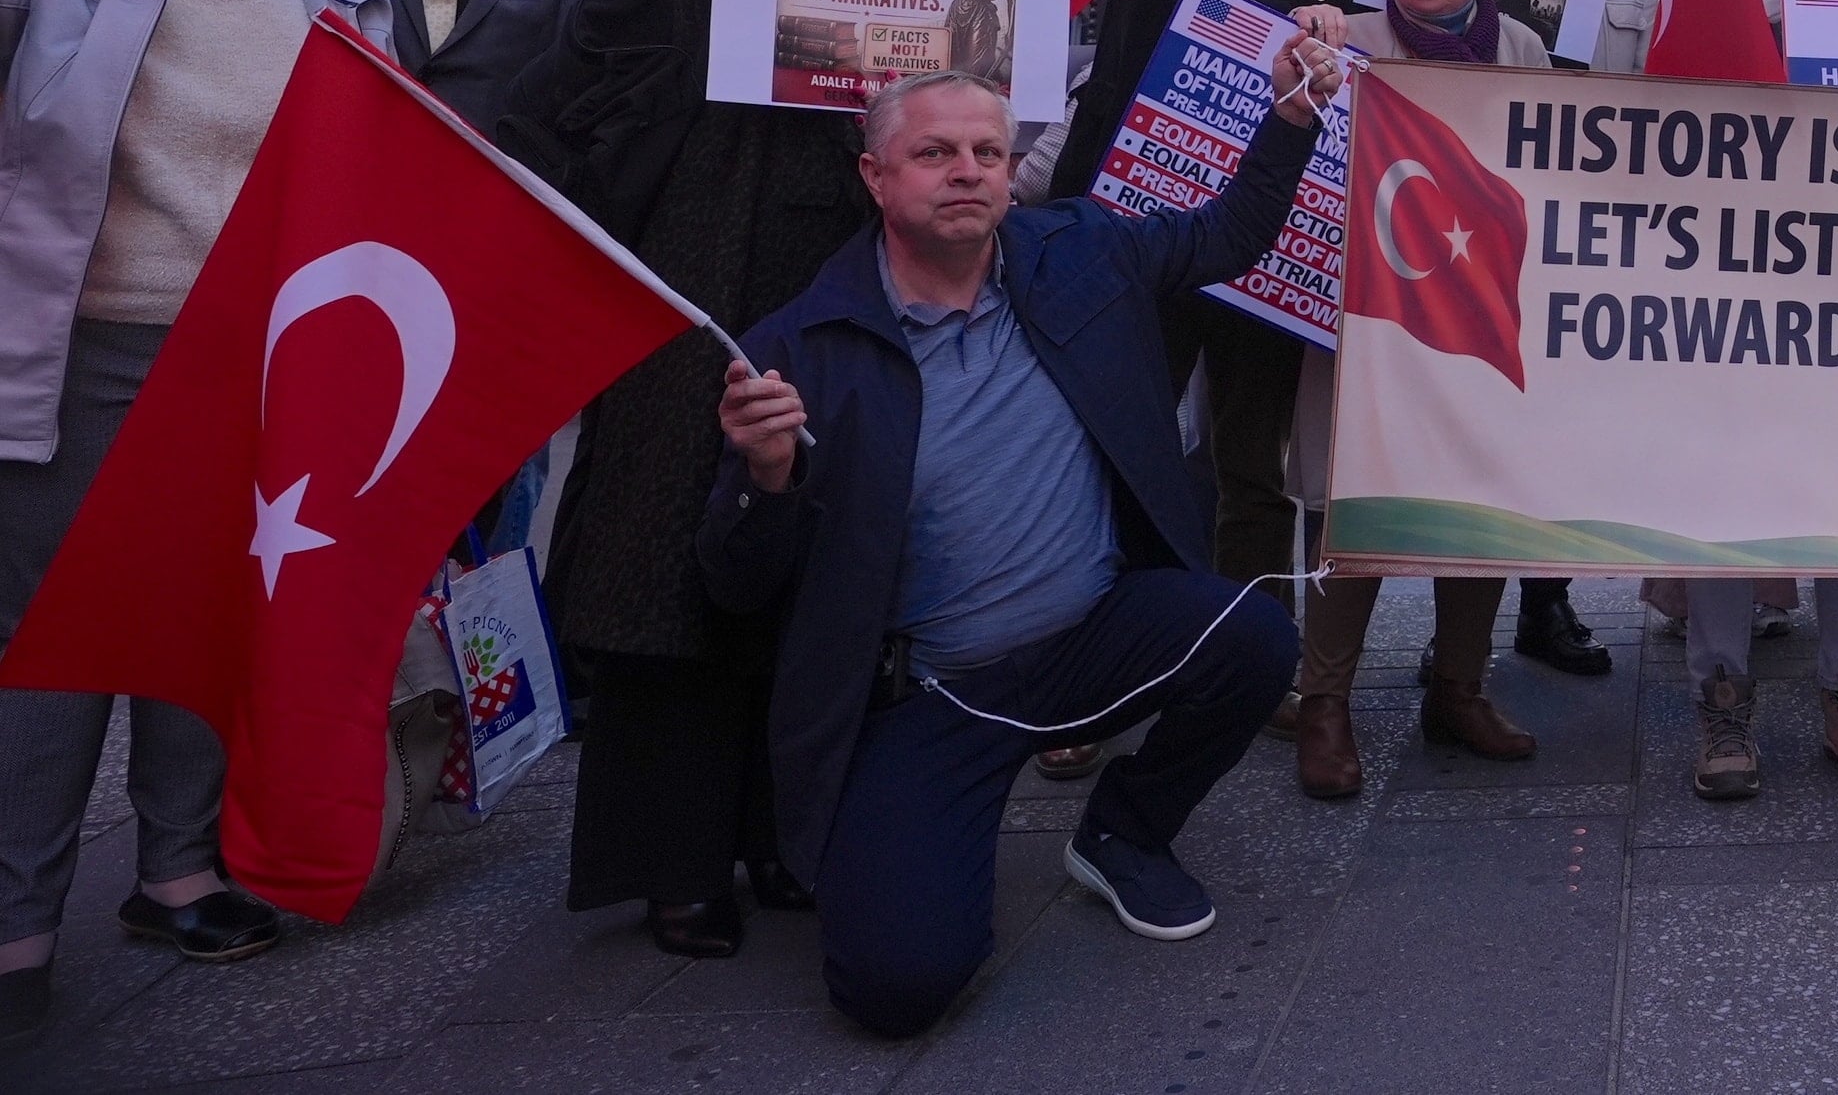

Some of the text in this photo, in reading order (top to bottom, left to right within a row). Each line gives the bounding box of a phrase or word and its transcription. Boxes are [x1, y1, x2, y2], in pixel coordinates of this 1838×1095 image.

[891, 30, 930, 44] FACTS
[891, 43, 920, 56] NOT
[873, 56, 940, 70] NARRATIVES
[811, 74, 855, 89] ADALET
[1173, 68, 1209, 94] OF
[1505, 100, 1794, 182] HISTORY
[1138, 139, 1214, 190] EQUAL
[1127, 161, 1212, 209] PRESU
[1290, 236, 1326, 264] OF
[1542, 200, 1699, 271] LET'S
[1275, 256, 1337, 301] TRIAL
[1247, 273, 1339, 330] OF POW
[472, 615, 517, 646] PICNIC
